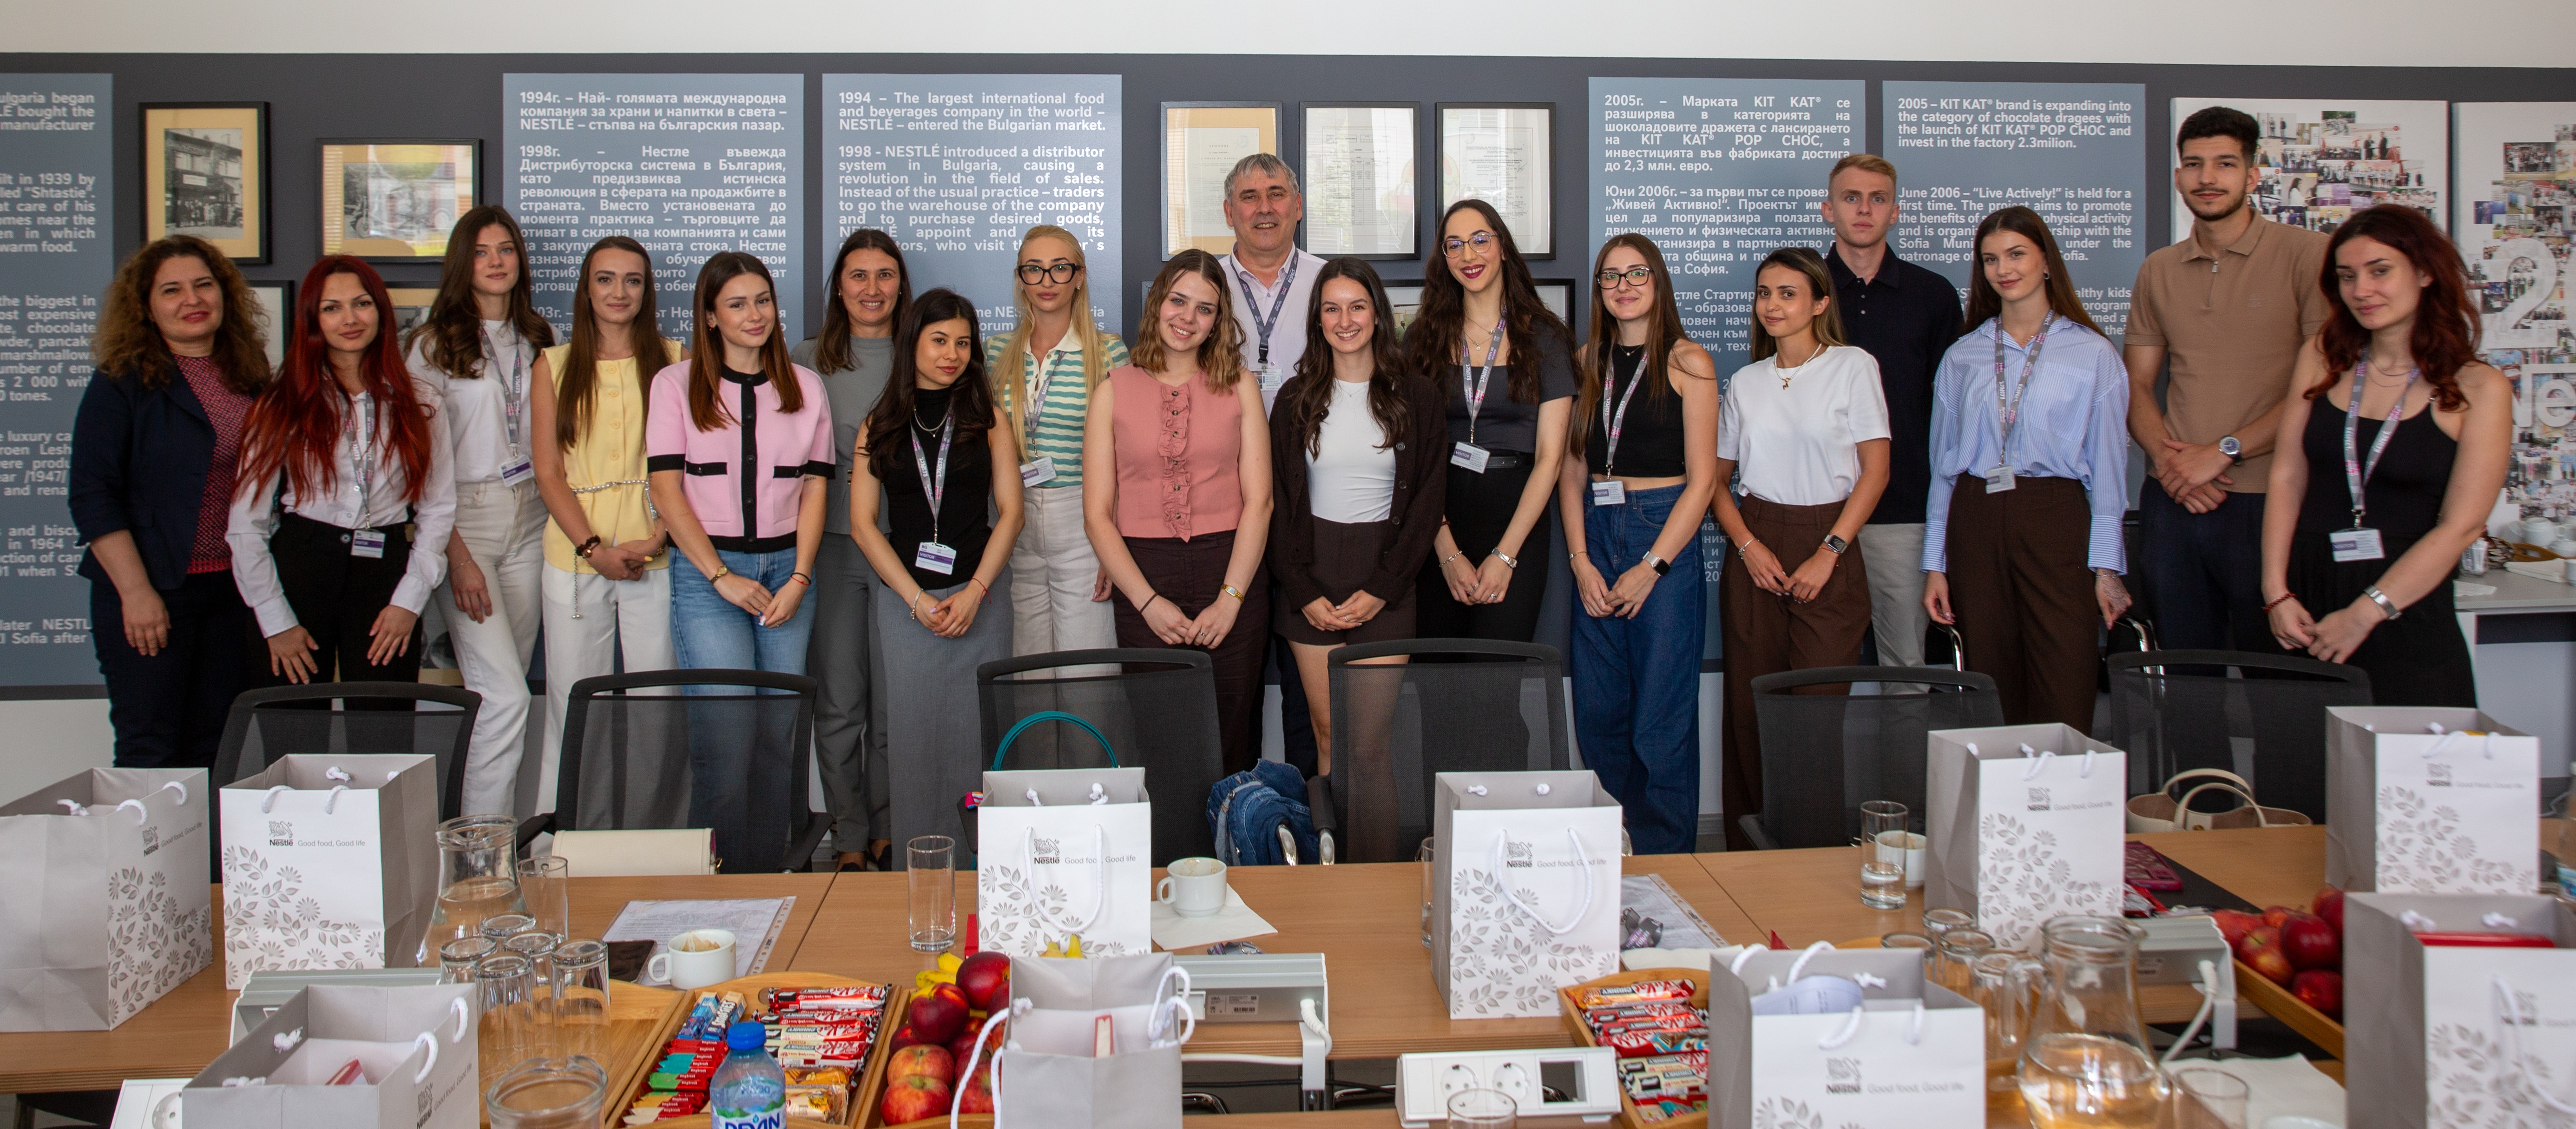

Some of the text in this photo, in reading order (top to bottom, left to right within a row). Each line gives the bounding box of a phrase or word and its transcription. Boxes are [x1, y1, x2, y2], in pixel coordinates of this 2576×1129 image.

[52, 92, 95, 106] began
[520, 91, 560, 103] 1994г.
[616, 94, 678, 104] голямата
[683, 94, 786, 106] международна
[839, 92, 1104, 106] 1994 The largest international food
[1604, 94, 1644, 106] 2005г.
[1682, 95, 1738, 109] Марката
[1754, 96, 1775, 107] KIT
[1836, 99, 1851, 108] се
[17, 105, 95, 119] bought the
[839, 105, 1092, 120] and beverages company in the world
[1898, 98, 1928, 109] 2005
[1940, 99, 1960, 109] KIT
[1996, 99, 2030, 110] brand
[2033, 99, 2043, 111] is
[2045, 100, 2106, 114] expanding
[2109, 100, 2131, 111] into
[520, 108, 775, 119] компания за храни и напитки в света
[520, 117, 785, 133] NESTLÉ стъпва на българския пазар.
[840, 117, 1106, 133] NESTLÉ entered the Bulgarian market.
[1898, 123, 1918, 134] the
[1922, 124, 1961, 135] launch
[1965, 124, 1978, 135] of
[1982, 124, 2002, 135] KIT
[2040, 124, 2066, 136] POP
[2070, 124, 2106, 136] CHOC
[2109, 125, 2131, 136] and
[1605, 136, 1620, 145] на
[1641, 133, 1663, 145] KIT
[1735, 134, 1762, 145] POP
[1781, 134, 1823, 148] CHOC,
[1843, 138, 1850, 146] а
[1898, 136, 1934, 147] invest
[1937, 136, 1948, 147] in
[1951, 136, 1971, 147] the
[1973, 136, 2016, 150] factory
[519, 145, 786, 158] 1998г. Нестле въвежда
[839, 144, 1105, 158] 1998 NESTLÉ introduced a distributor
[1605, 147, 1851, 162] инвестицията във фабриката достига
[839, 159, 1104, 173] system in Bulgaria, causing a
[1604, 159, 1713, 173] до 2,3 млн. евро.
[19, 172, 96, 187] in 1939 by
[520, 175, 786, 186] като предизвиква истинска
[1898, 187, 1928, 199] June
[1930, 187, 1960, 198] 2006
[2064, 187, 2075, 198] is
[2077, 187, 2103, 198] held
[2105, 187, 2123, 198] for
[2124, 190, 2132, 198] a
[16, 200, 96, 212] care of his
[1739, 198, 1798, 212] Проектът
[2083, 202, 2132, 213] promote
[2091, 213, 2132, 225] activity
[2065, 238, 2132, 248] under the
[2108, 287, 2132, 298] kids
[25, 294, 96, 309] biggest in
[27, 308, 97, 322] expensive
[7, 430, 52, 444] luxury
[30, 538, 64, 550] 1964
[17, 565, 56, 577] when
[11, 632, 87, 645] Sofia after
